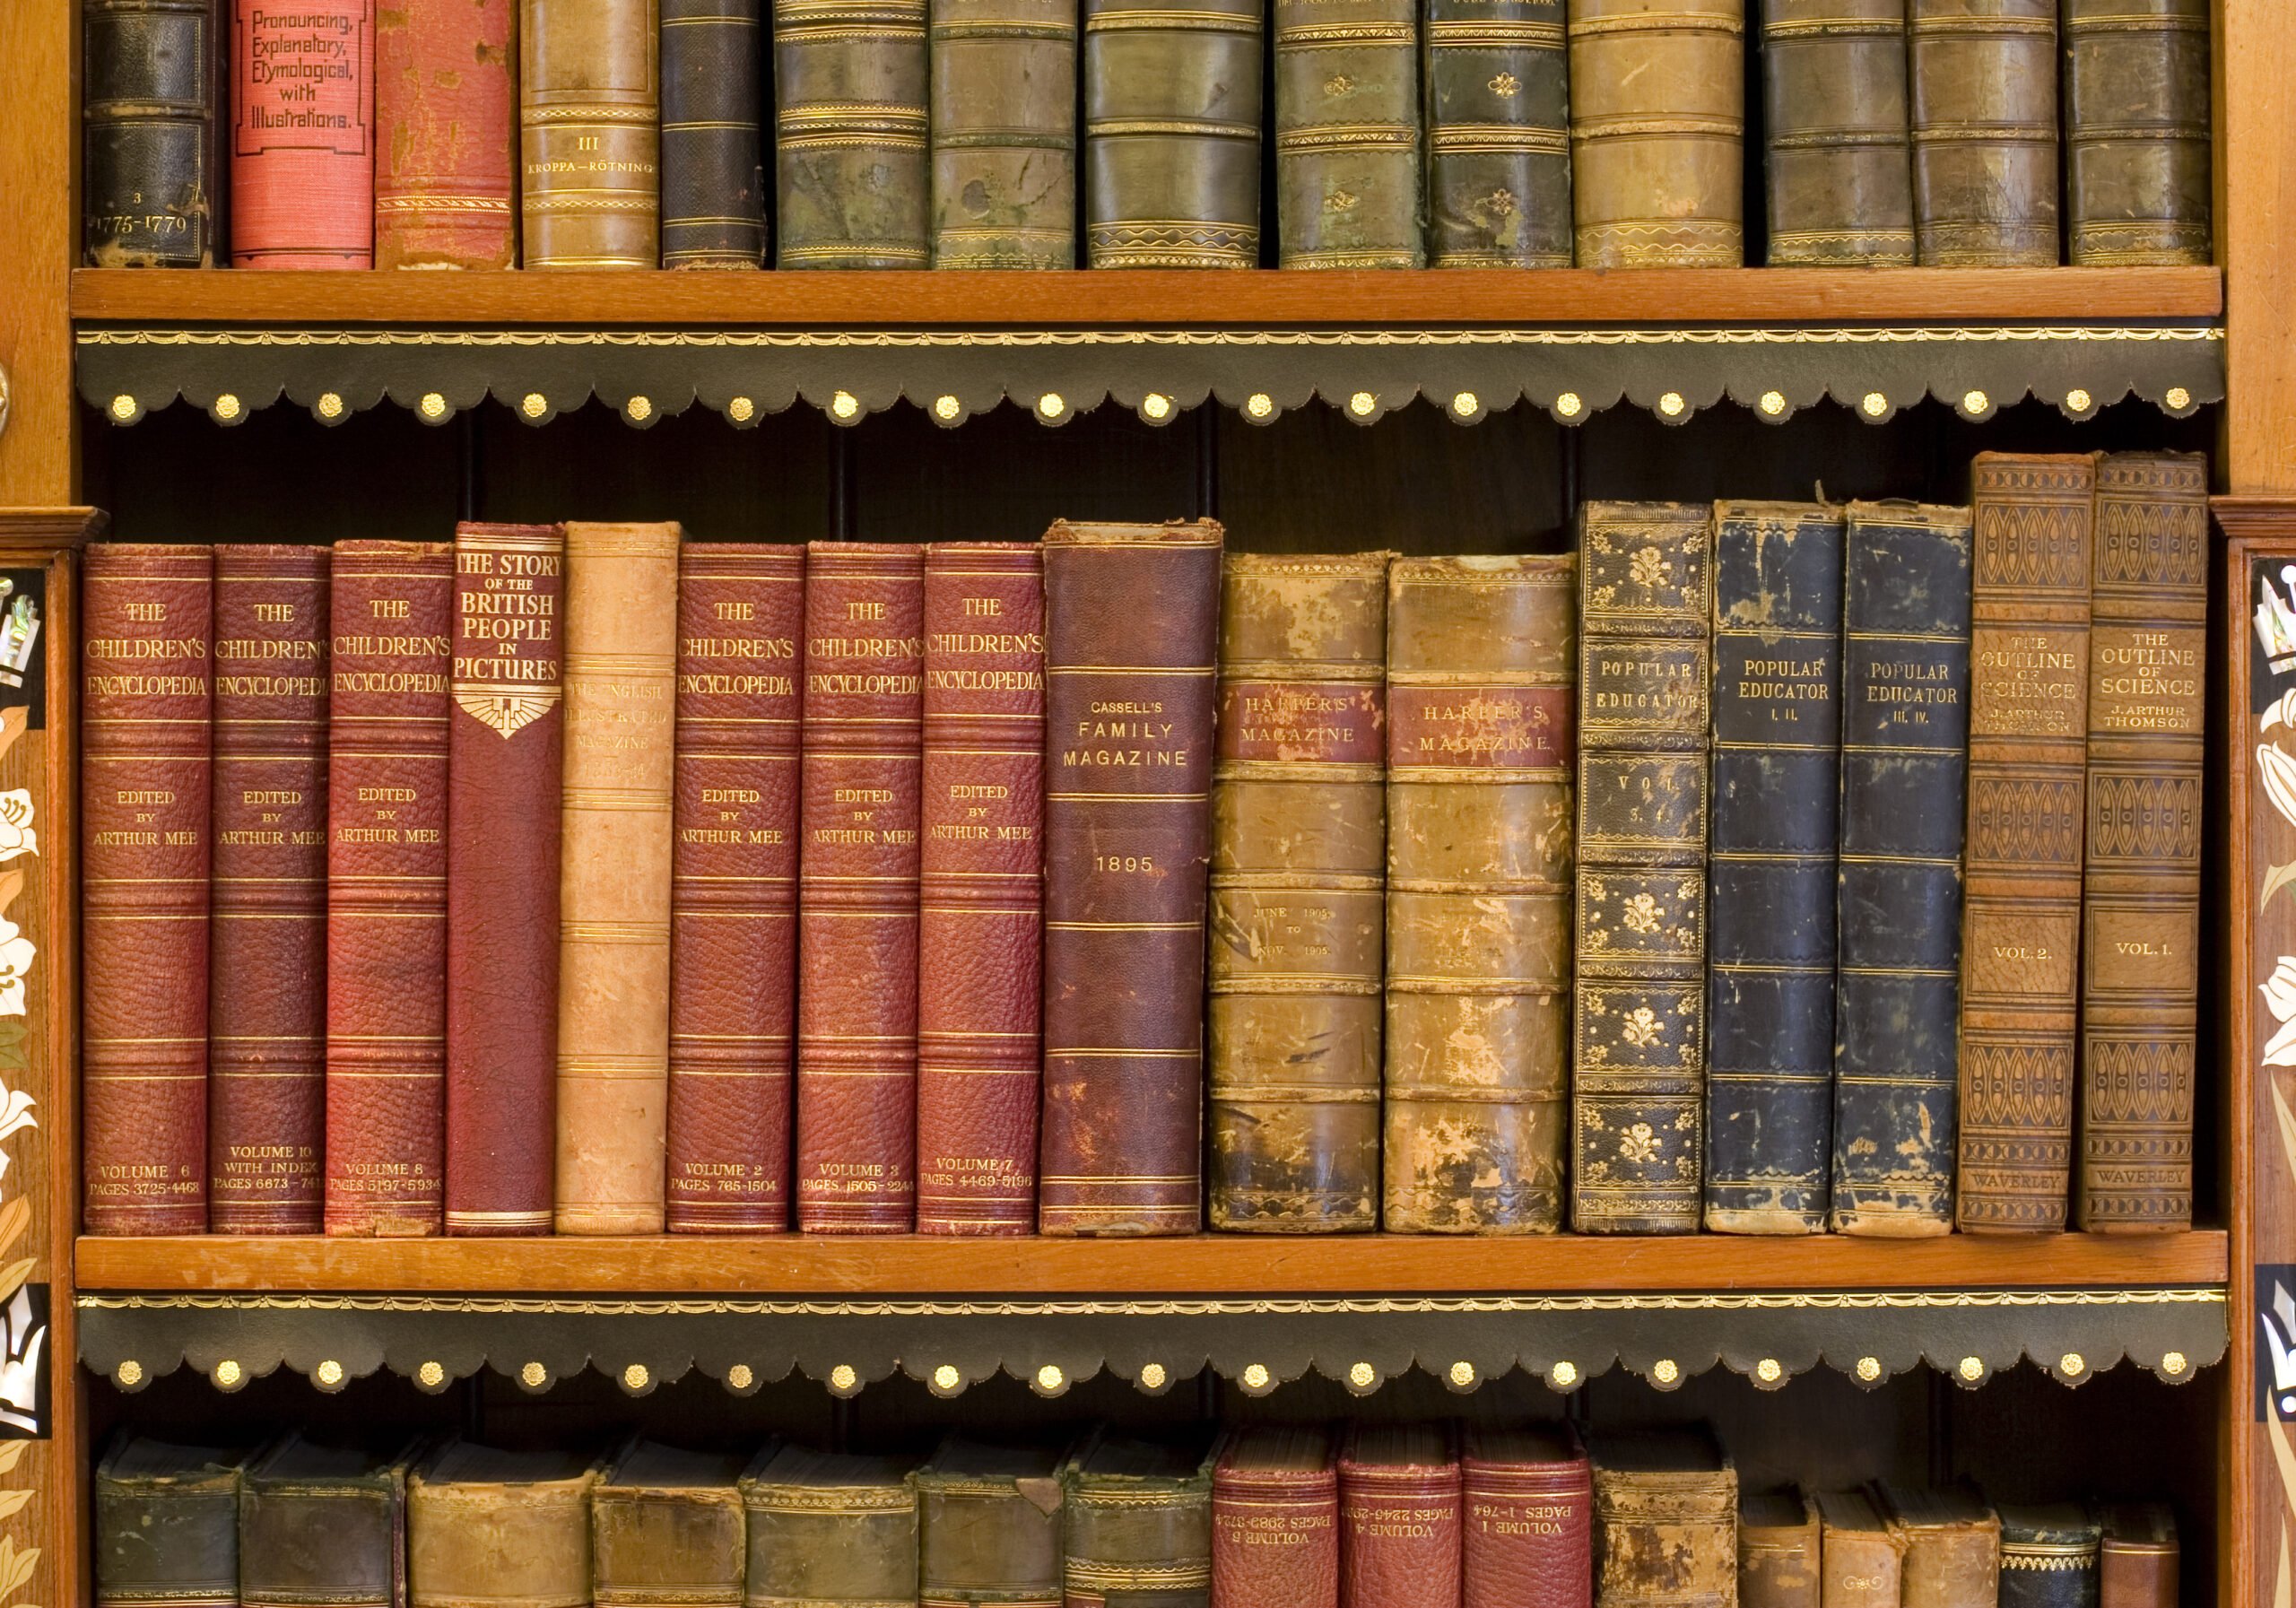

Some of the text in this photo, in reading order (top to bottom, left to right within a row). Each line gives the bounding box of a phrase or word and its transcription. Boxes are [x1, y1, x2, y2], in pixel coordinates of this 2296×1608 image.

[252, 11, 353, 35] Pronouncing,
[252, 33, 346, 58] Explanatory,
[252, 57, 353, 83] Etymological,
[280, 83, 316, 101] with
[251, 106, 352, 129] Illustrations.
[578, 136, 599, 151] III
[134, 192, 142, 204] 3
[97, 215, 187, 233] 1775-1779
[457, 552, 561, 577] THE STORY
[485, 578, 534, 590] OF THE
[370, 600, 410, 618] THE
[461, 592, 554, 615] BRITISH
[962, 598, 1002, 615] THE
[126, 604, 166, 621] THE
[254, 604, 295, 621] THE
[715, 603, 754, 621] THE
[846, 603, 886, 620] THE
[463, 617, 552, 640] PEOPLE
[334, 634, 450, 656] CHILDREN'S
[809, 637, 924, 657] CHILDREN'S
[927, 633, 1044, 653] CHILDREN'S
[2011, 637, 2048, 648] THE
[2133, 634, 2169, 646] THE
[86, 638, 206, 658] CHILDREN'S
[215, 639, 331, 659] CHILDREN'
[499, 643, 517, 655] IN
[679, 638, 794, 658] CHILDREN'S
[1981, 652, 2075, 669] OUTLINE
[2101, 648, 2196, 666] OUTLINE
[454, 657, 557, 681] PICTURES
[1602, 661, 1692, 677] POPULAR
[1744, 660, 1823, 676] POPULAR
[1871, 663, 1949, 680] POPULAR
[2017, 670, 2039, 680] OF
[2138, 667, 2161, 677] OF
[87, 676, 206, 696] ENCYCLOPEDIA
[216, 676, 330, 696] ENCYCLOPEDI
[335, 674, 450, 693] ENCYCLOPEDIA
[678, 675, 793, 695] ENCYCLOPEDIA
[927, 671, 1045, 690] ENCYCLOPEDIA
[2101, 679, 2196, 696] SCIENCE
[1739, 682, 1829, 700] EDUCATOR
[1867, 686, 1958, 703] EDUCATOR
[1980, 682, 2076, 699] SCIENCE
[1246, 697, 1348, 711] HARPER'S
[1596, 692, 1698, 708] EDUCATOR
[1091, 702, 1162, 713] CASSELL'S
[1079, 722, 1172, 737] FAMILY
[2104, 717, 2190, 728] THOMSON
[1240, 727, 1354, 742] MAGAZINE
[1064, 751, 1187, 766] MAGAZINE
[117, 791, 175, 804] EDITED
[243, 791, 301, 804] EDITED
[359, 788, 416, 802] EDITED
[702, 789, 760, 803] EDITED
[835, 789, 893, 803] EDITED
[951, 786, 1008, 798] EDITED
[136, 813, 155, 822] BY
[263, 813, 282, 822] BY
[377, 811, 396, 820] BY
[721, 812, 739, 821] BY
[854, 812, 873, 821] BY
[969, 808, 987, 817] BY
[93, 831, 197, 846] ARTHUR MEE
[221, 831, 326, 845] ARTHUR MEE
[337, 829, 439, 843] ARTHUR MEE
[681, 830, 783, 844] ARTHUR MEE
[813, 830, 917, 844] ARTHUR MEE
[931, 826, 1031, 839] ARTHUR MEE
[1096, 856, 1152, 872] 1895
[1254, 907, 1287, 917] JUNE
[1286, 926, 1301, 934] TO
[230, 1146, 312, 1158] VOLUME 10
[224, 1162, 318, 1174] WITH INDEX
[345, 1163, 423, 1175] VOLUME 8
[686, 1163, 762, 1176] VOLUME 2
[820, 1164, 900, 1177] VOLUME 3
[936, 1158, 1013, 1170] VOLUME 7
[100, 1165, 191, 1178] VOLUME 6
[2097, 1169, 2186, 1183] WAVERLEY
[213, 1178, 252, 1189] PAGES
[330, 1178, 441, 1191] PAGES 5197-5934
[671, 1178, 776, 1191] PAGES 765-1504
[803, 1179, 839, 1191] PAGES
[922, 1173, 1032, 1186] PAGES 4469-5196
[1972, 1174, 2060, 1189] WAVERLEY
[90, 1182, 199, 1195] PAGES 3725-4468
[1414, 1508, 1454, 1520] PAGES
[1525, 1507, 1571, 1517] PAGES
[1291, 1516, 1331, 1528] PAGES
[1496, 1522, 1562, 1534] VOLUME
[1355, 1524, 1434, 1536] VOLUME 4
[1232, 1532, 1309, 1544] VOLUME 5
